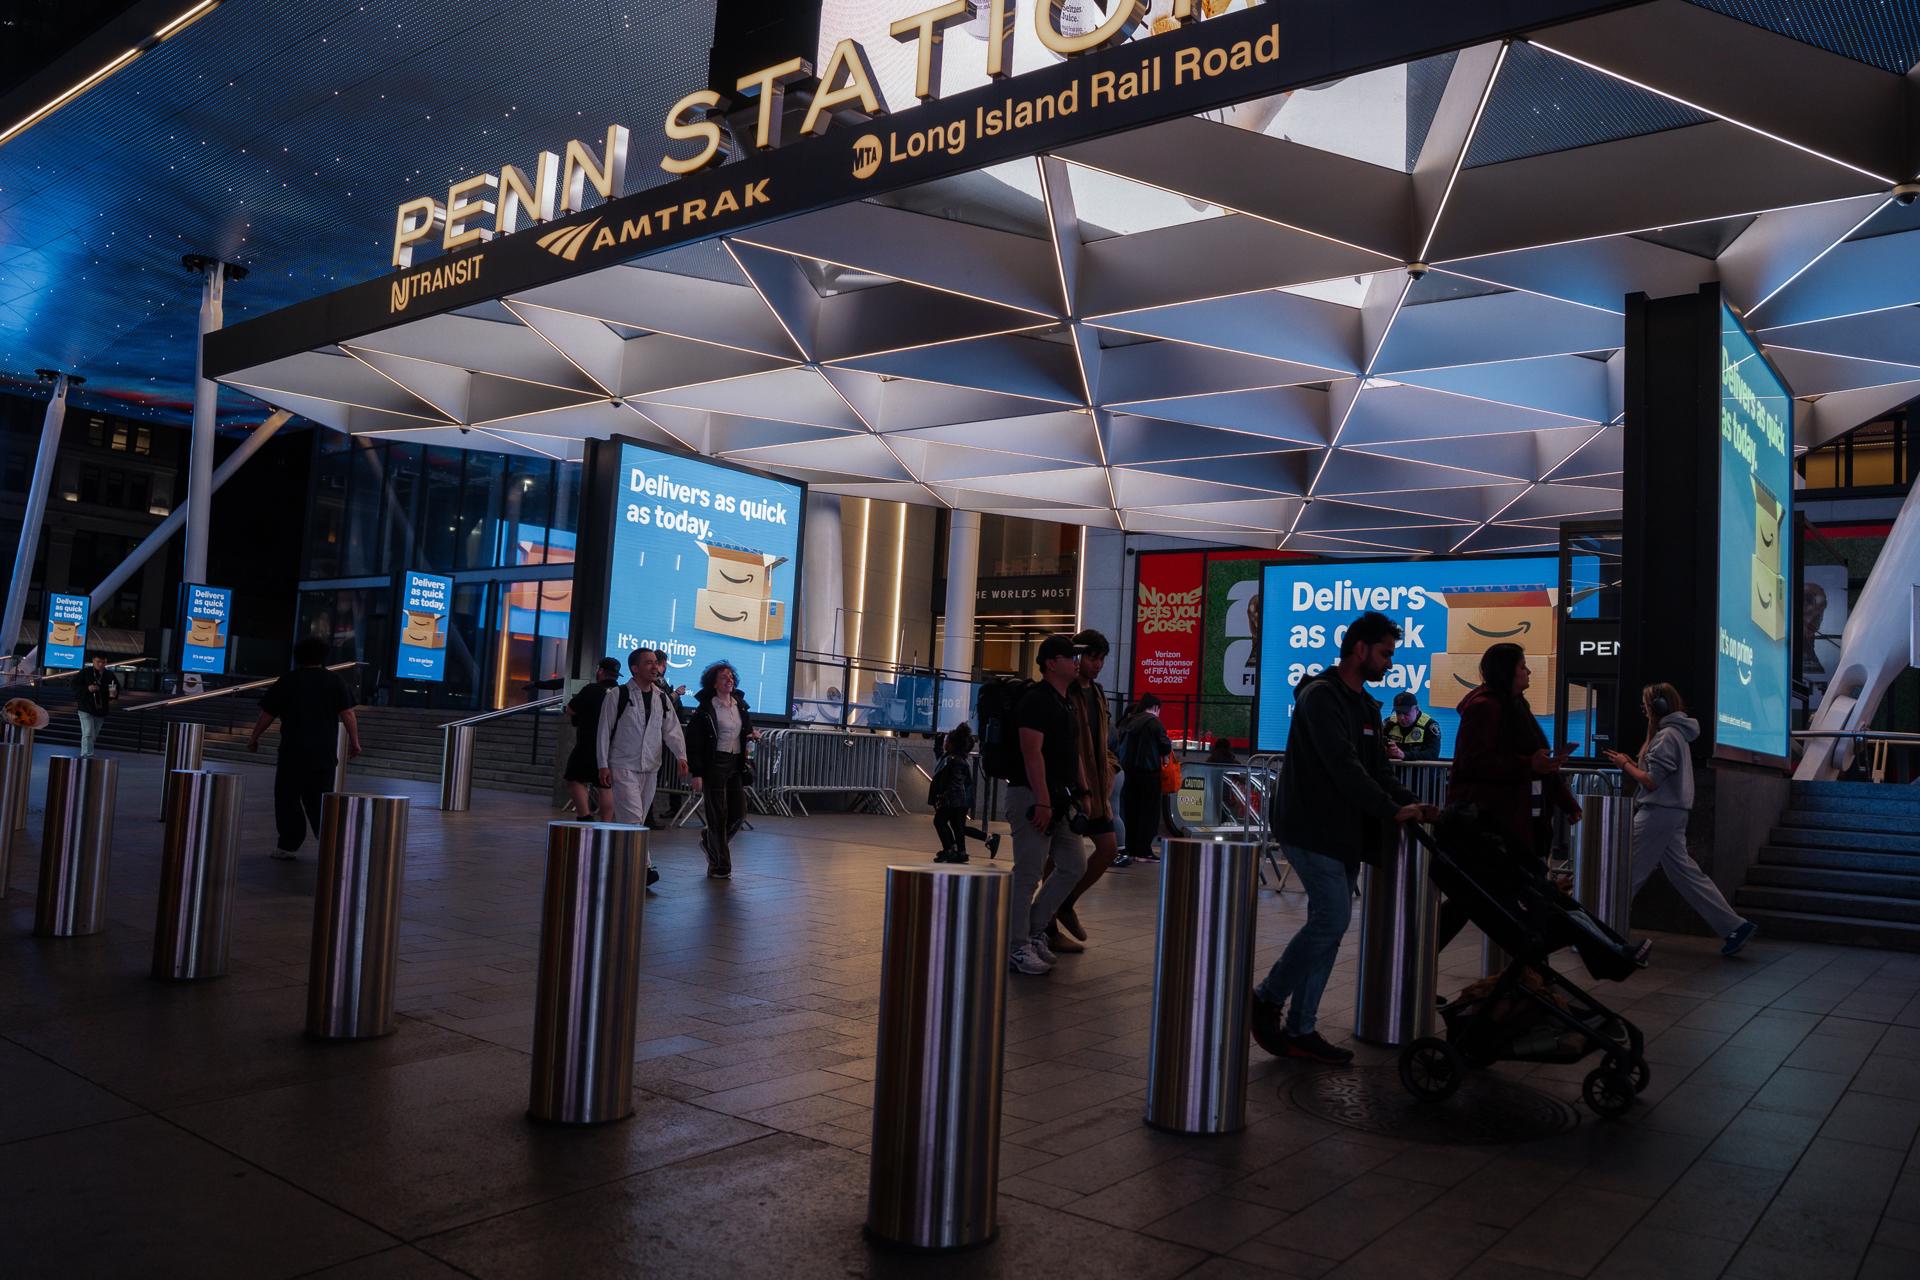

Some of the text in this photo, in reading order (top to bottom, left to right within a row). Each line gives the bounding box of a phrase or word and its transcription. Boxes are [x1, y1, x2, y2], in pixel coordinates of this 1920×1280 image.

[890, 119, 966, 163] Long
[976, 80, 1079, 139] Island
[1091, 56, 1161, 104] Rail
[1175, 24, 1280, 86] Road
[392, 0, 1257, 268] PENN STATIO
[592, 177, 771, 251] AMTRAK
[1722, 345, 1785, 457] Delivers as quick
[1721, 406, 1732, 442] as
[630, 468, 787, 526] Delivers as quick
[626, 503, 713, 540] as today.
[412, 576, 445, 590] Delivers
[195, 589, 224, 600] Delivers
[422, 588, 444, 599] quick
[975, 588, 1073, 599] HE WORLD'S MOST
[1139, 581, 1203, 605] No one
[1292, 580, 1426, 612] Delivers
[56, 597, 83, 606] Delivers
[64, 605, 82, 613] quick
[421, 598, 445, 610] today.
[64, 612, 83, 620] today.
[203, 607, 225, 616] today.
[1138, 604, 1202, 622] gets you
[1143, 617, 1196, 634] closer
[1289, 624, 1326, 648] as
[617, 633, 638, 650] It's
[660, 640, 696, 657] prime
[1580, 641, 1621, 656] PEN
[1155, 650, 1181, 658] Verizon
[1165, 660, 1194, 668] sponsor
[1148, 676, 1163, 684] Cup
[1242, 673, 1255, 685] FI
